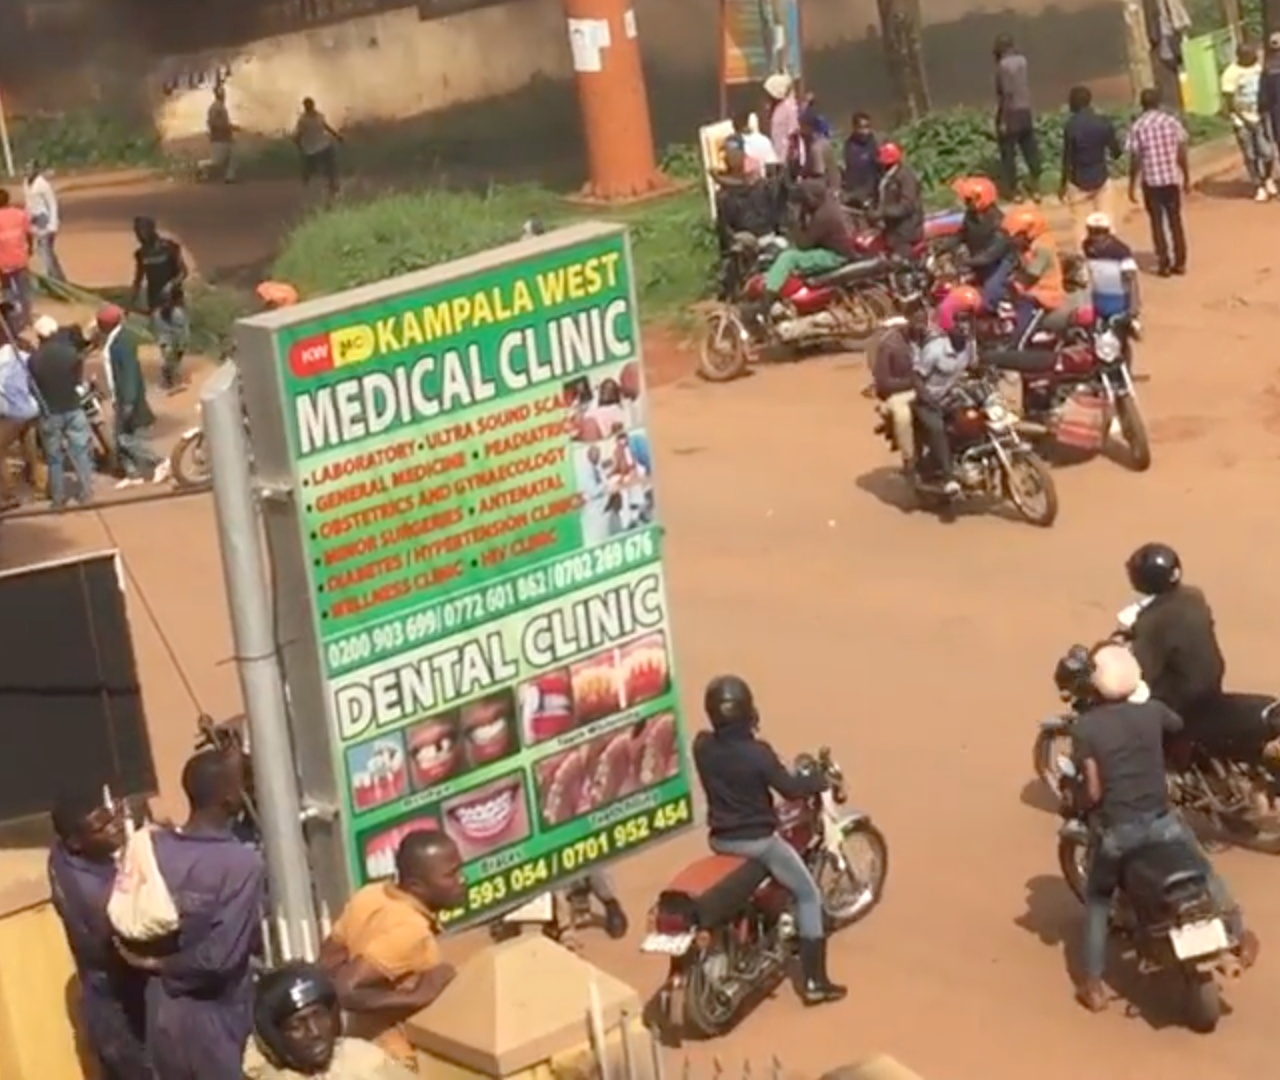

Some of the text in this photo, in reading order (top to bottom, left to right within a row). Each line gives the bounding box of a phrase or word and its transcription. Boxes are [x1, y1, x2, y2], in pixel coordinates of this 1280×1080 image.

[377, 252, 619, 353] KAMPALA WEST
[296, 300, 631, 454] MEDICAL CLINIC
[301, 344, 328, 362] KW
[312, 440, 414, 485] LABORATORY
[427, 423, 472, 449] ULTRA
[477, 405, 529, 433] SOUND
[316, 477, 387, 512] GENERAL
[393, 453, 464, 488] MEDICINE
[321, 446, 564, 539] OBSTETRICS AND GYNAECOLOGY
[480, 474, 562, 513] ANTENATAL
[327, 632, 370, 668] 0200
[372, 620, 403, 652] 903
[443, 592, 483, 627] 0772
[485, 582, 513, 611] 601
[554, 554, 592, 587] 0702
[625, 532, 652, 561] 676
[415, 562, 462, 589] CLINIC
[335, 572, 662, 741] DENTAL CLINIC
[469, 878, 505, 909] 593
[511, 860, 547, 890] 054
[562, 834, 607, 868] 0701
[615, 817, 648, 846] 952
[654, 800, 687, 829] 454
